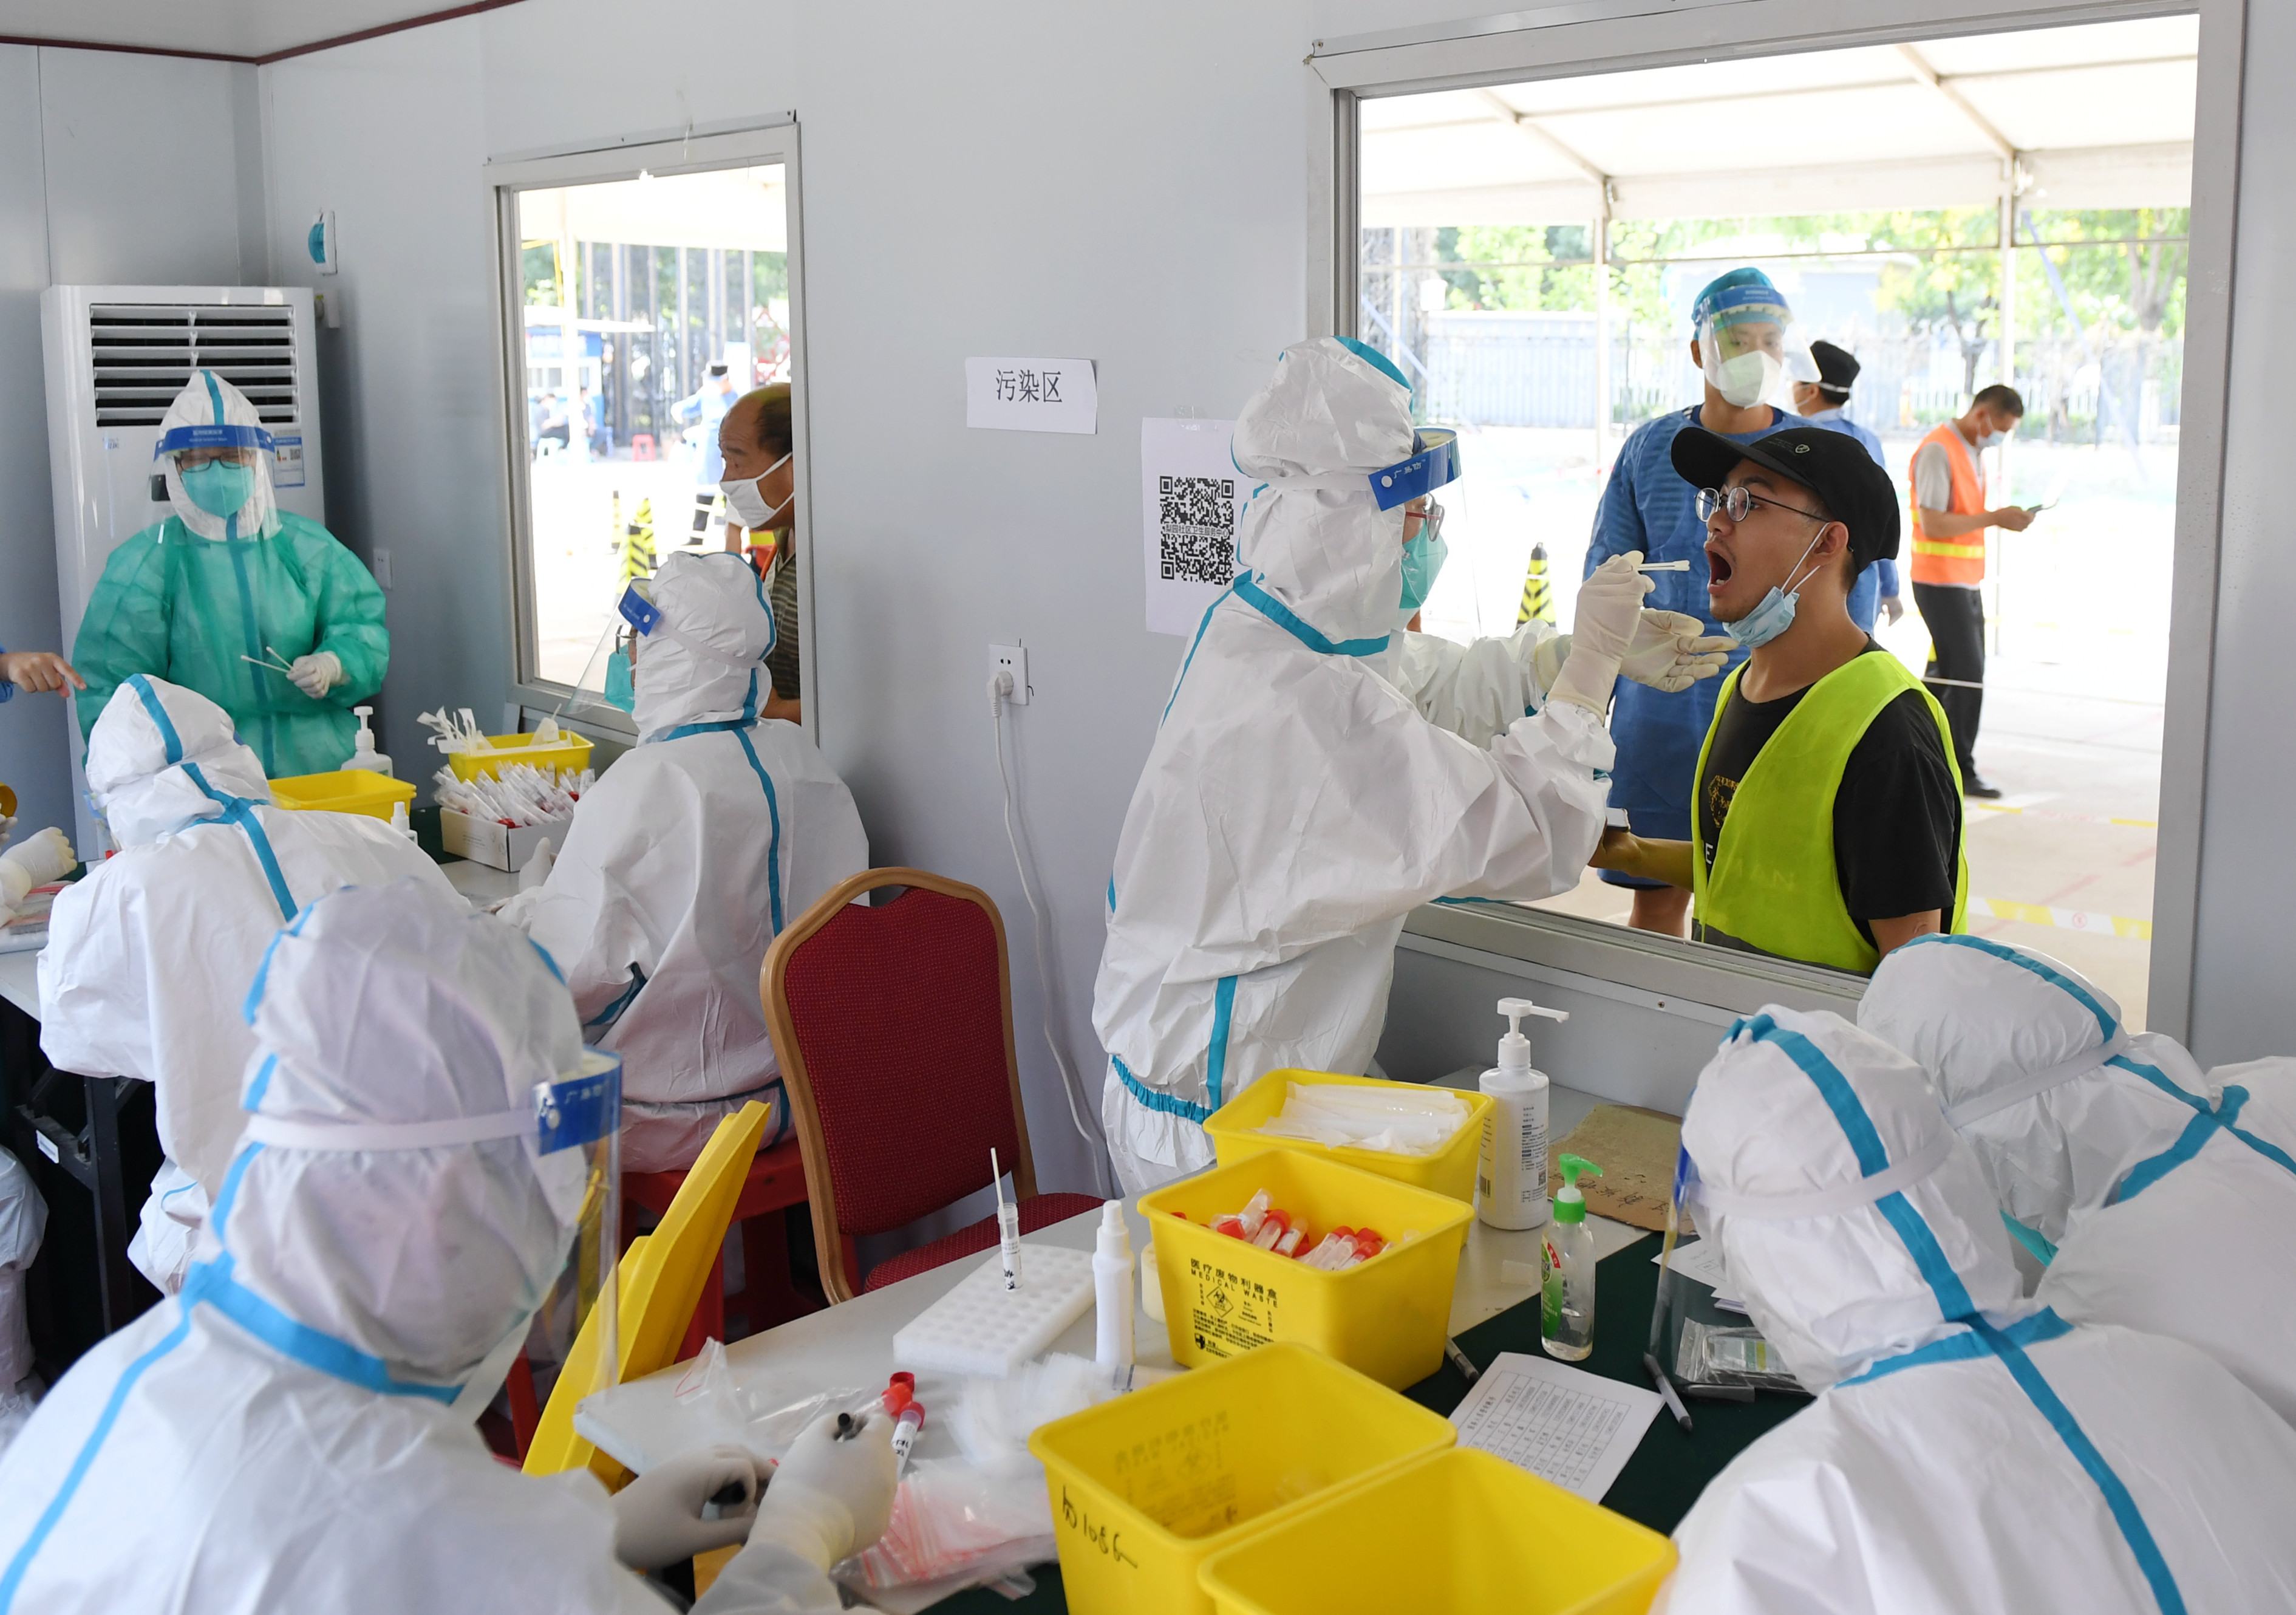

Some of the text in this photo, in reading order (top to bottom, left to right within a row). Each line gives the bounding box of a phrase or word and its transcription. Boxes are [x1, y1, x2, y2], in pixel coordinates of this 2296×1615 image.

[995, 369, 1062, 403] 污染区
[1165, 524, 1228, 538] 梨园社区卫生服务中心
[1191, 1268, 1236, 1292] MEDICAL
[1243, 1289, 1278, 1308] WASTE
